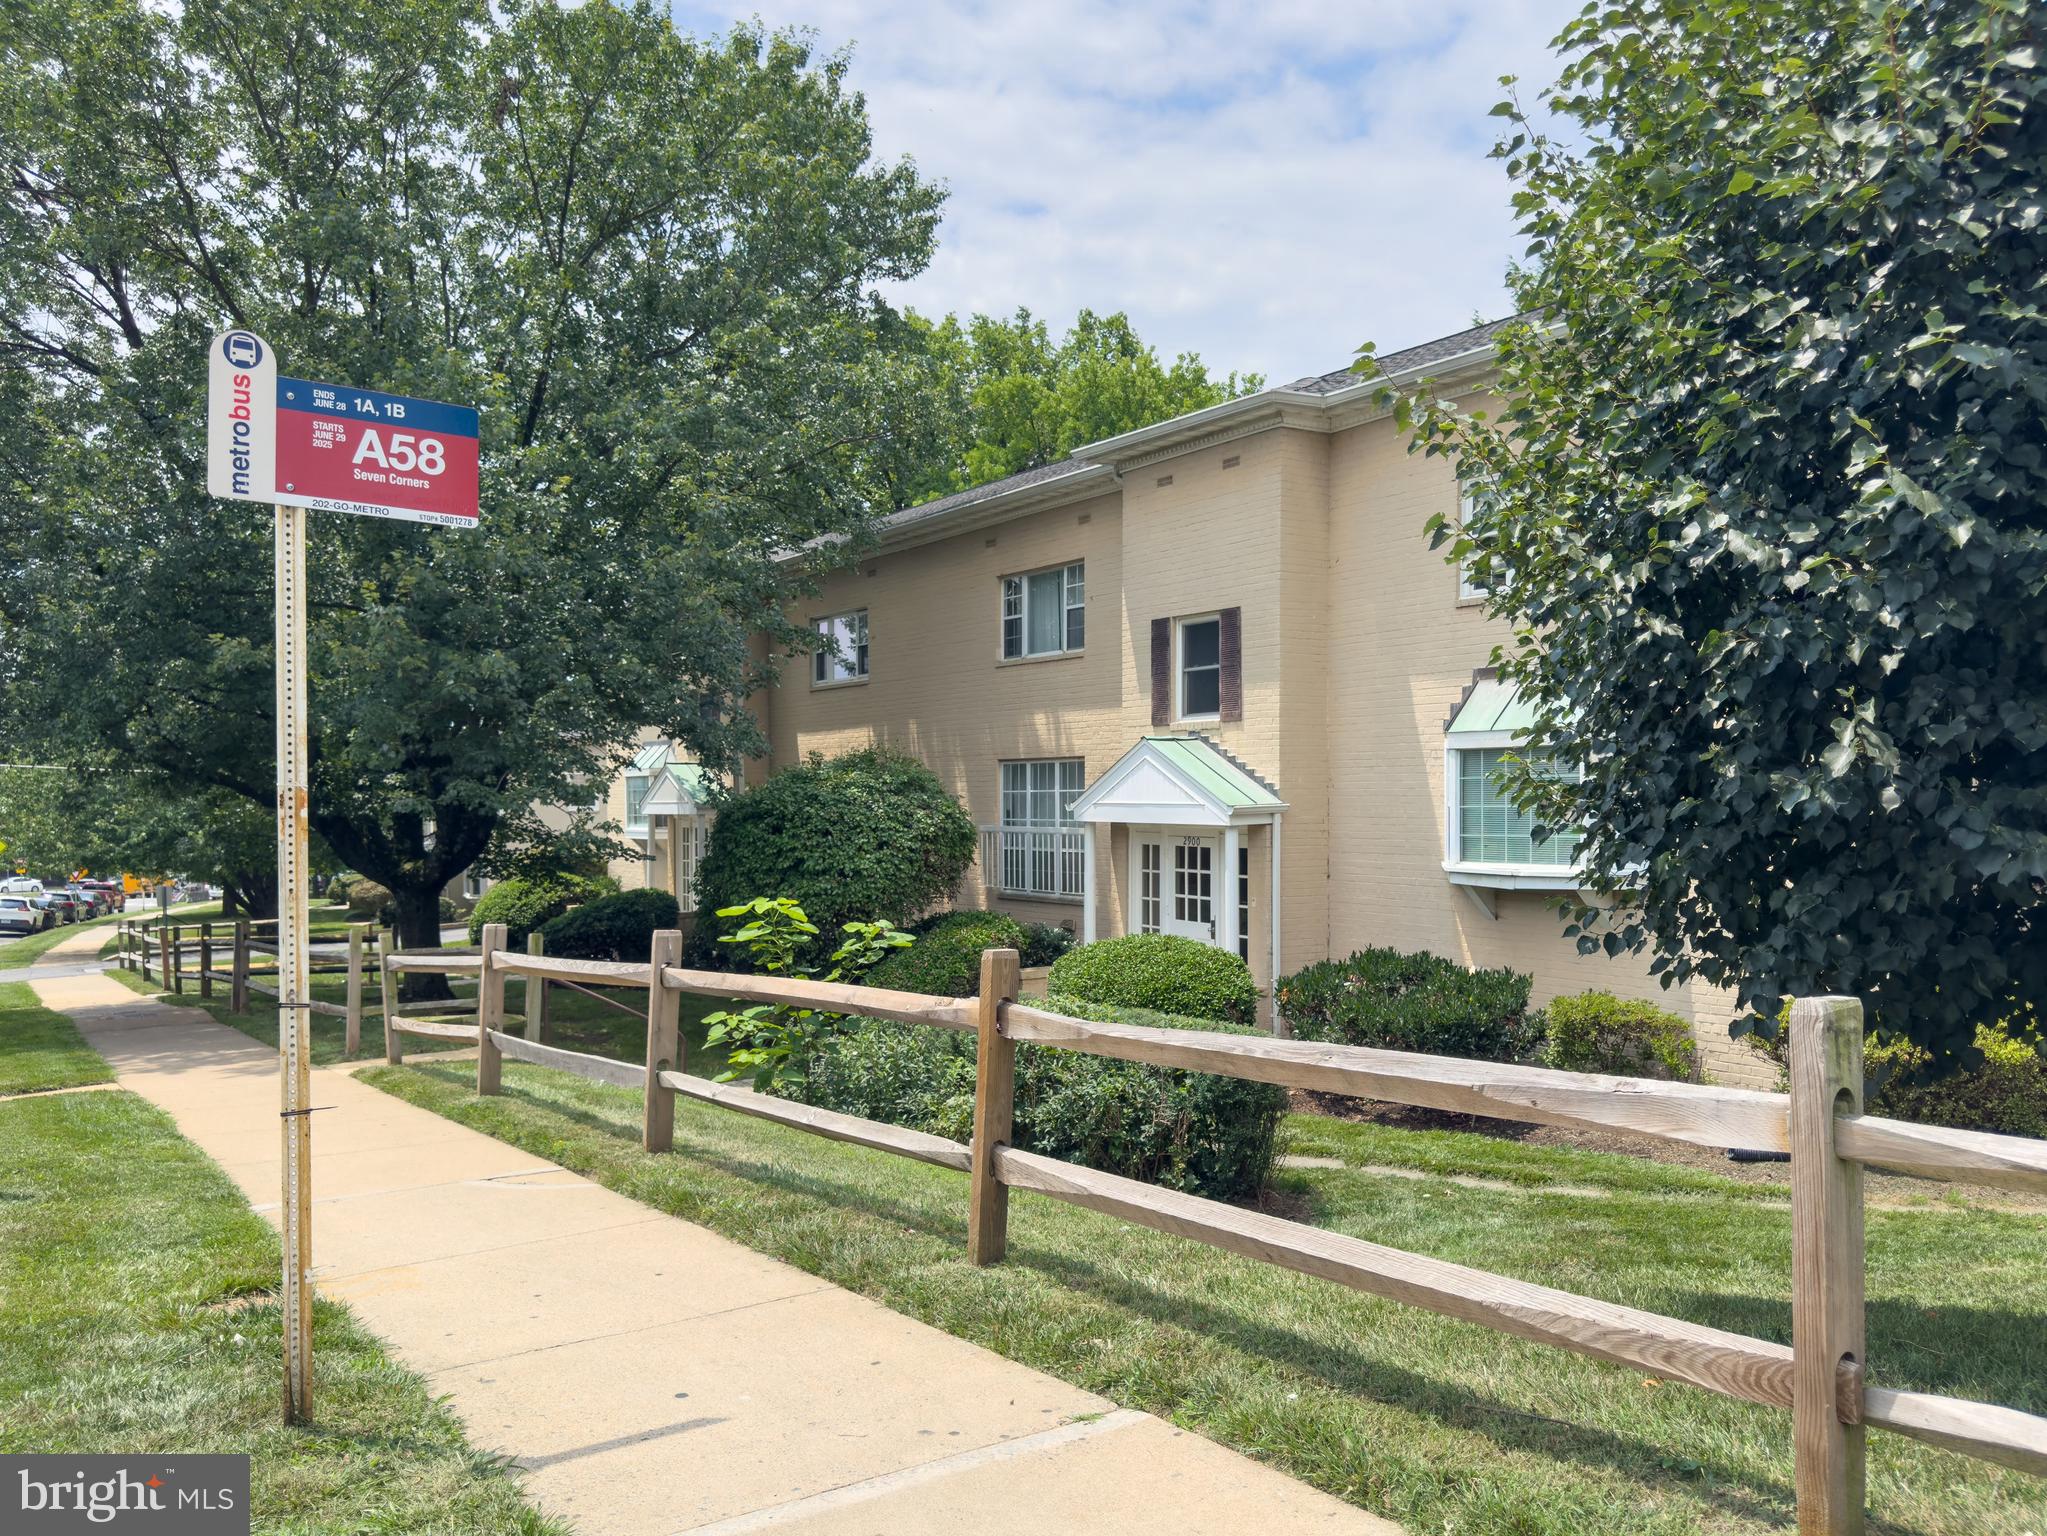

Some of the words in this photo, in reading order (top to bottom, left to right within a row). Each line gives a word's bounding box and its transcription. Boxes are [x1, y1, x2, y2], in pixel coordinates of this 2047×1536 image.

[313, 389, 335, 400] ENDS
[313, 399, 334, 410] JUNE
[336, 401, 347, 411] 28
[354, 399, 380, 417] 1A,
[384, 403, 405, 418] 1B
[312, 421, 344, 433] STARTS
[228, 374, 251, 495] metrobus
[312, 430, 334, 440] JUNE
[335, 433, 346, 442] 29
[312, 439, 333, 449] 2025
[352, 429, 446, 476] A58
[353, 468, 386, 484] Seven
[389, 473, 430, 489] Corners
[312, 499, 390, 516] 202-GO-METRO
[439, 515, 473, 527] 5001278
